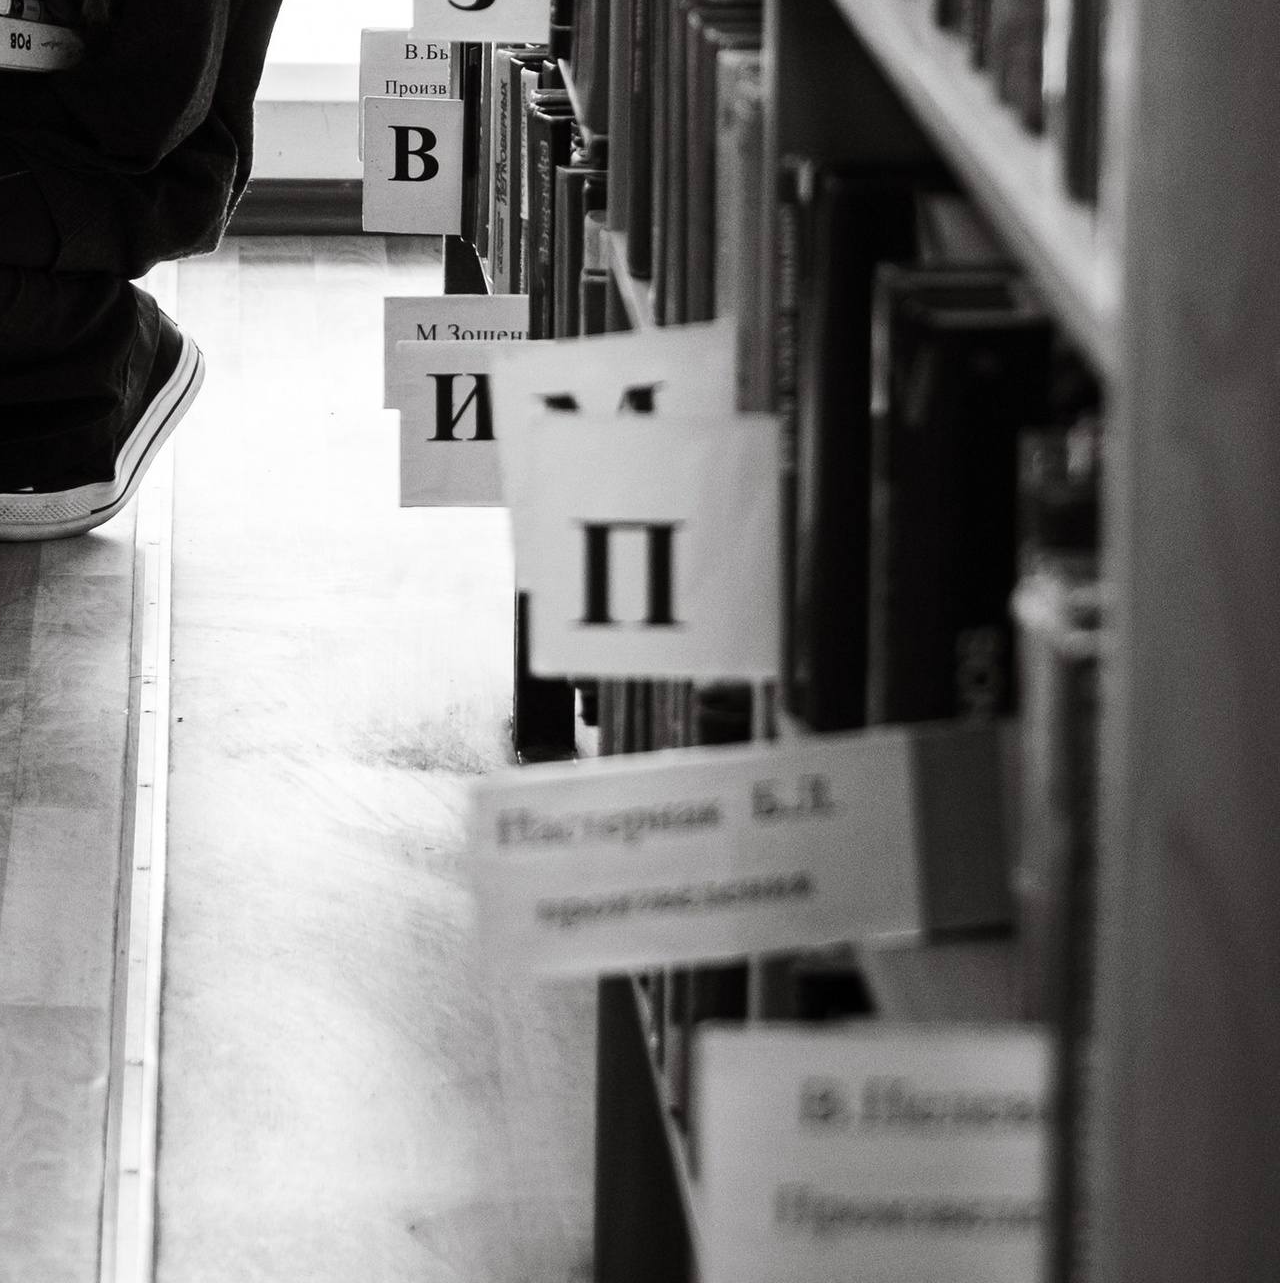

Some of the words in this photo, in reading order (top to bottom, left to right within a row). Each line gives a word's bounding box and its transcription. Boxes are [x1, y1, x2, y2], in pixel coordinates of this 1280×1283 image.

[387, 124, 440, 183] В
[426, 373, 497, 441] И
[570, 517, 686, 629] П
